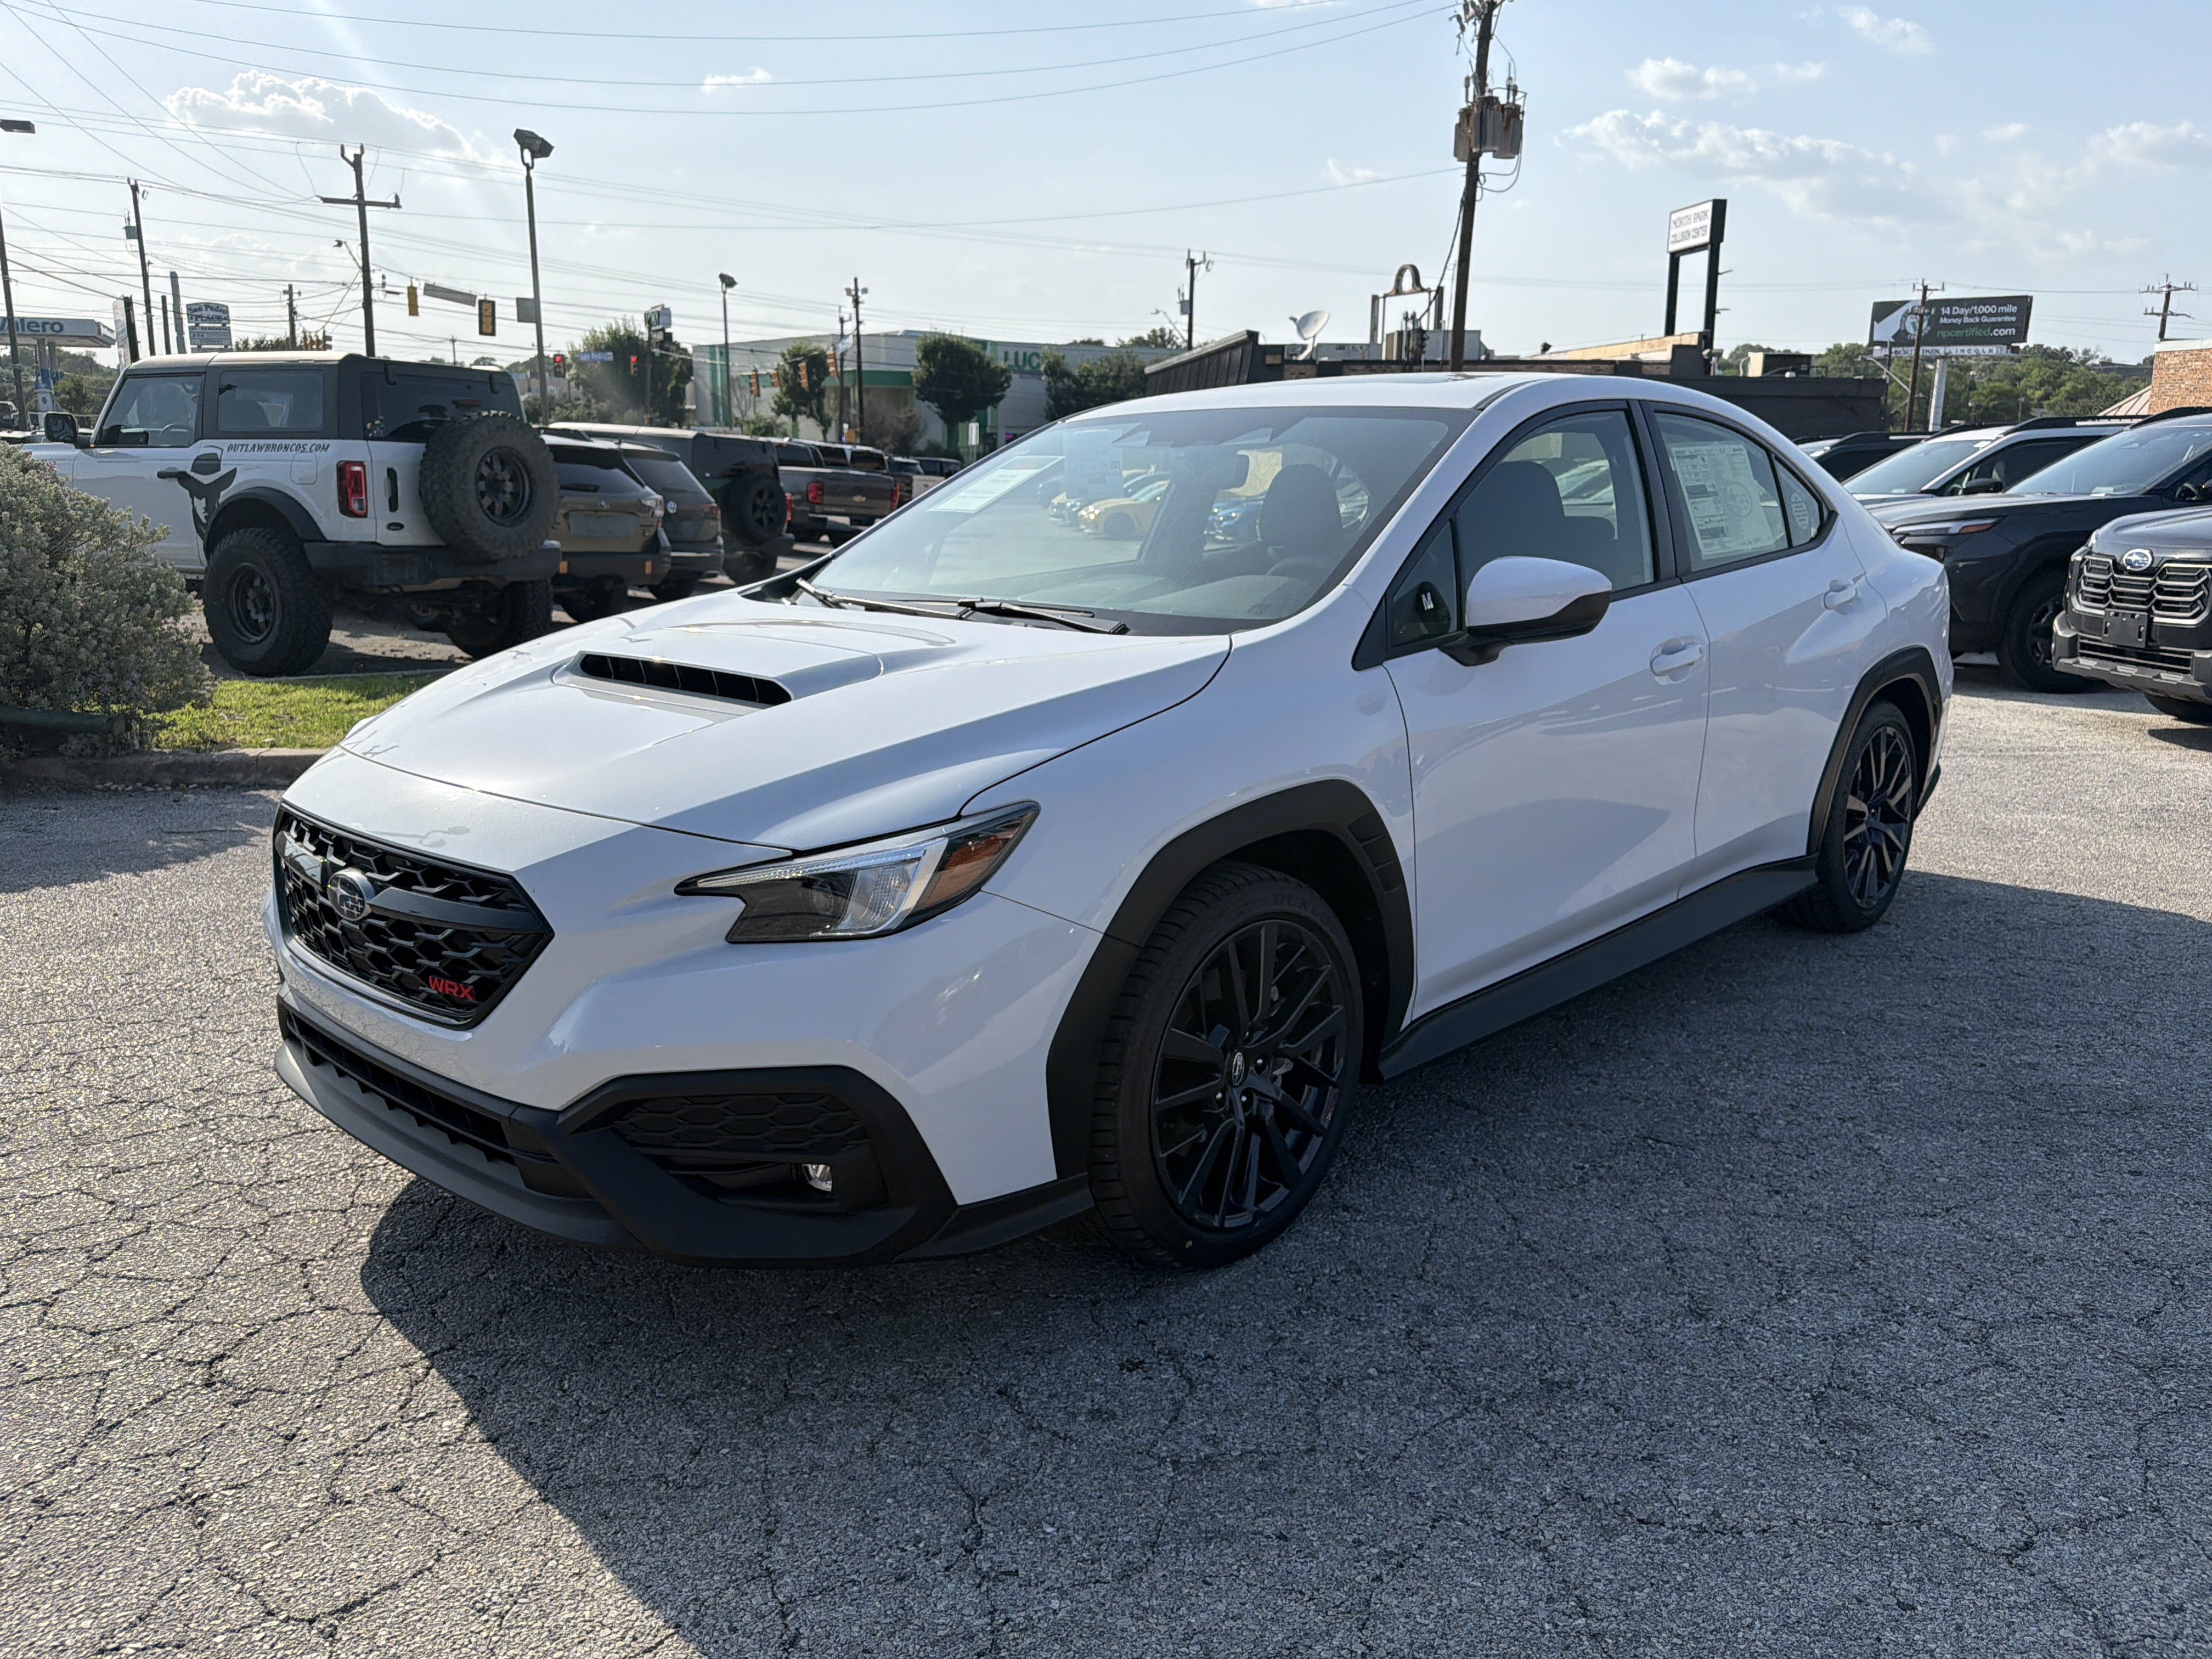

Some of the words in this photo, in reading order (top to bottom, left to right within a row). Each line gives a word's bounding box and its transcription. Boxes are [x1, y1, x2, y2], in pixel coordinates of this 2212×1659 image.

[1940, 306, 1950, 315] 14
[1997, 304, 2018, 313] mile
[227, 443, 330, 454] OUTLAWBRONCOS.COM
[428, 975, 476, 1001] WRX
